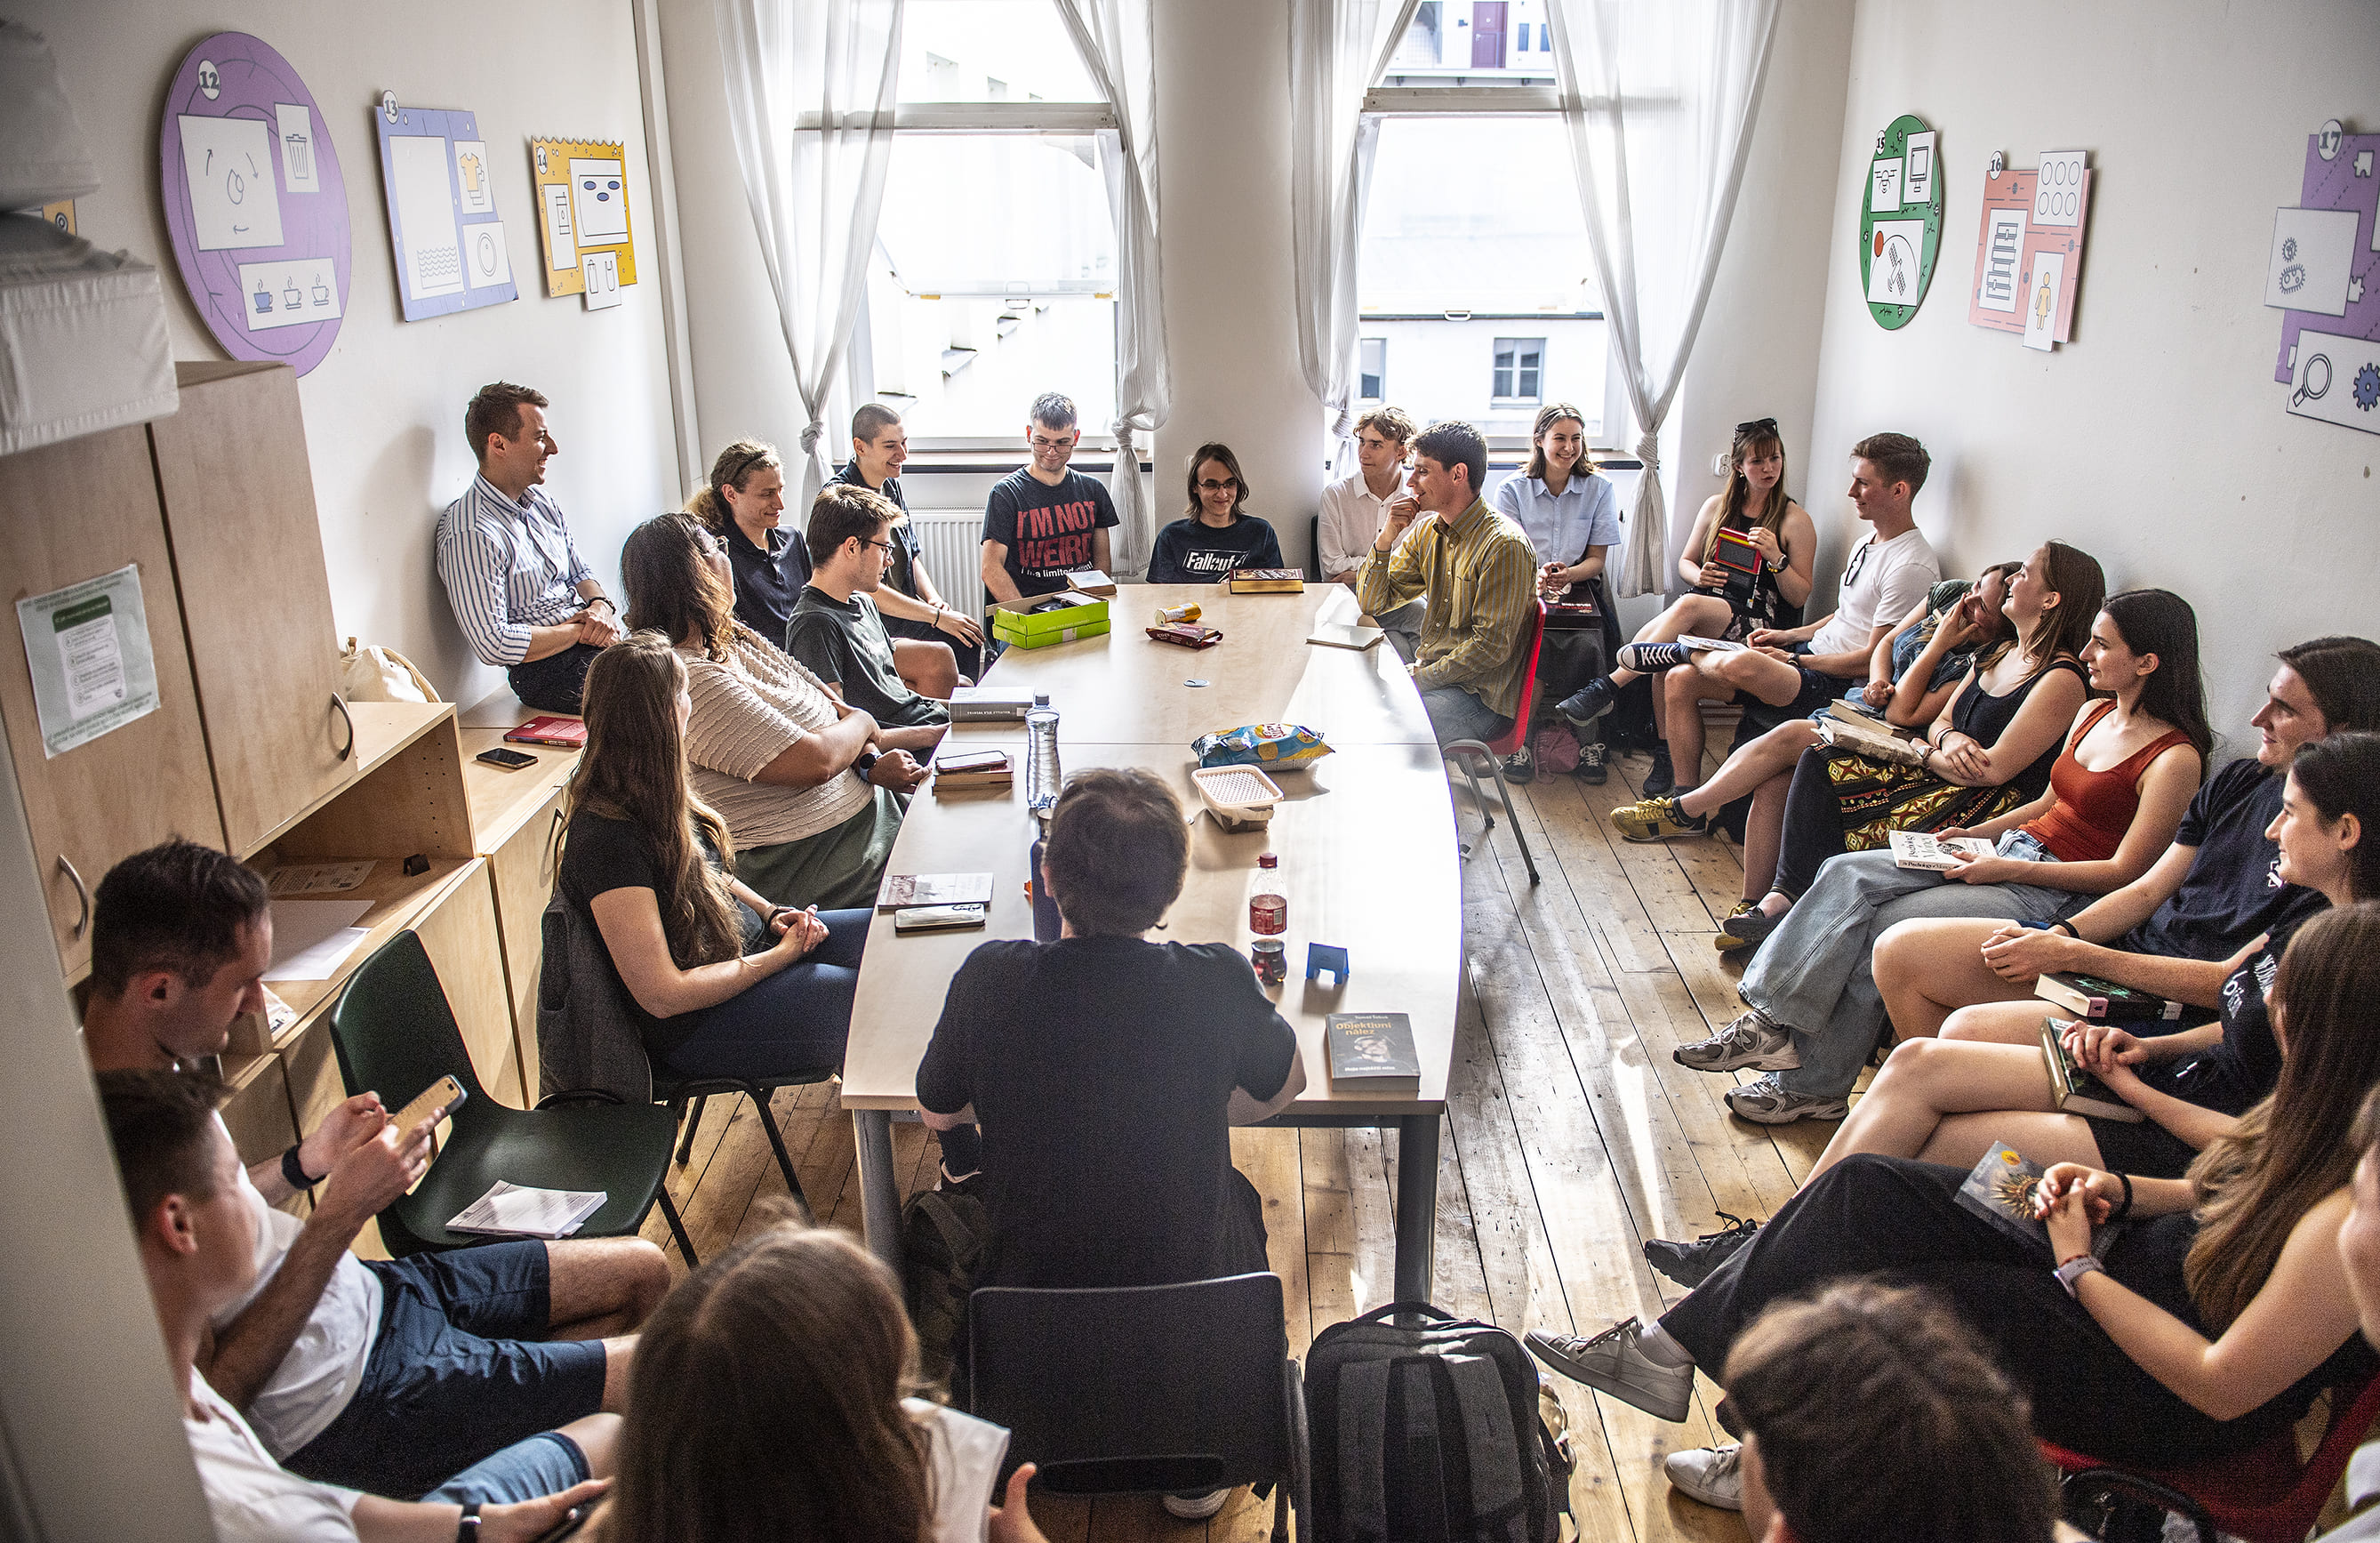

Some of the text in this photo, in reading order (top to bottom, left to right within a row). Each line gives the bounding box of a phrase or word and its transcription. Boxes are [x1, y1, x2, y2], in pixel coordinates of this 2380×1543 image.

[199, 70, 220, 91] 12
[384, 99, 398, 117] 13
[1876, 137, 1886, 149] 15
[2319, 130, 2342, 153] 17
[537, 154, 548, 168] 14
[1991, 157, 2001, 172] 16
[1016, 501, 1095, 539] I'M NOT
[1186, 551, 1236, 572] Fallout
